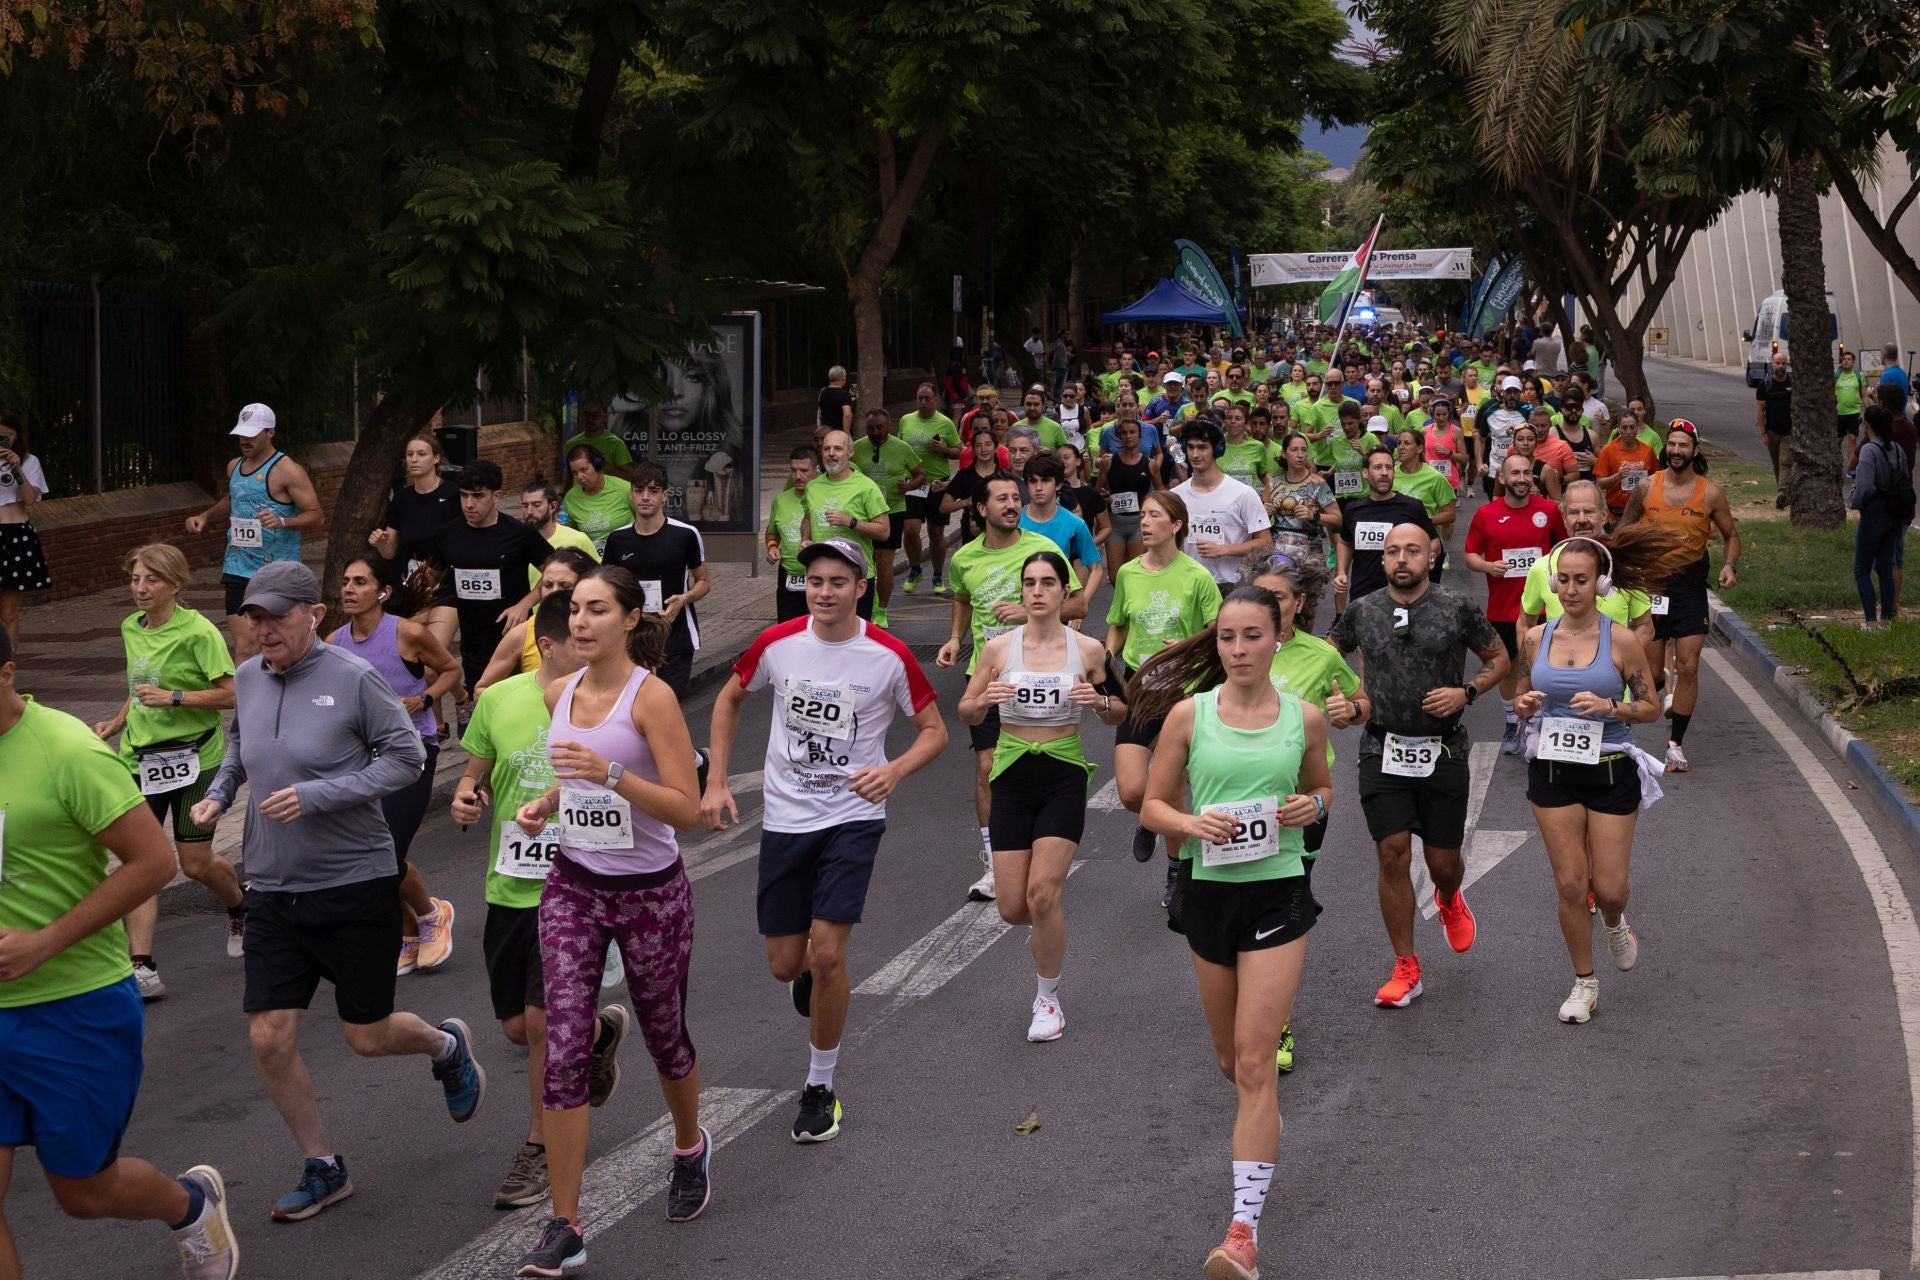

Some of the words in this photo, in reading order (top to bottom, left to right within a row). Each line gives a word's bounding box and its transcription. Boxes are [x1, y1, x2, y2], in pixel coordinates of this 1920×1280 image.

[1308, 254, 1348, 263] Carrera
[1380, 252, 1417, 260] Prensa
[623, 432, 667, 441] CABLLO
[682, 432, 727, 441] GLOSSY
[630, 443, 637, 451] 4
[1338, 478, 1358, 487] 649
[1114, 498, 1133, 508] 997
[234, 527, 255, 539] 110
[1191, 524, 1220, 534] 1149
[1360, 531, 1385, 542] 709
[461, 580, 493, 591] 863
[790, 575, 806, 585] 84
[1016, 687, 1060, 705] 951
[790, 696, 841, 722] 220
[1549, 732, 1591, 750] 193
[807, 741, 826, 755] EL
[808, 752, 849, 767] PALO
[1391, 749, 1432, 763] 353
[147, 763, 190, 781] 203
[564, 808, 622, 828] 1080
[1220, 819, 1268, 846] 20
[508, 841, 561, 862] 146
